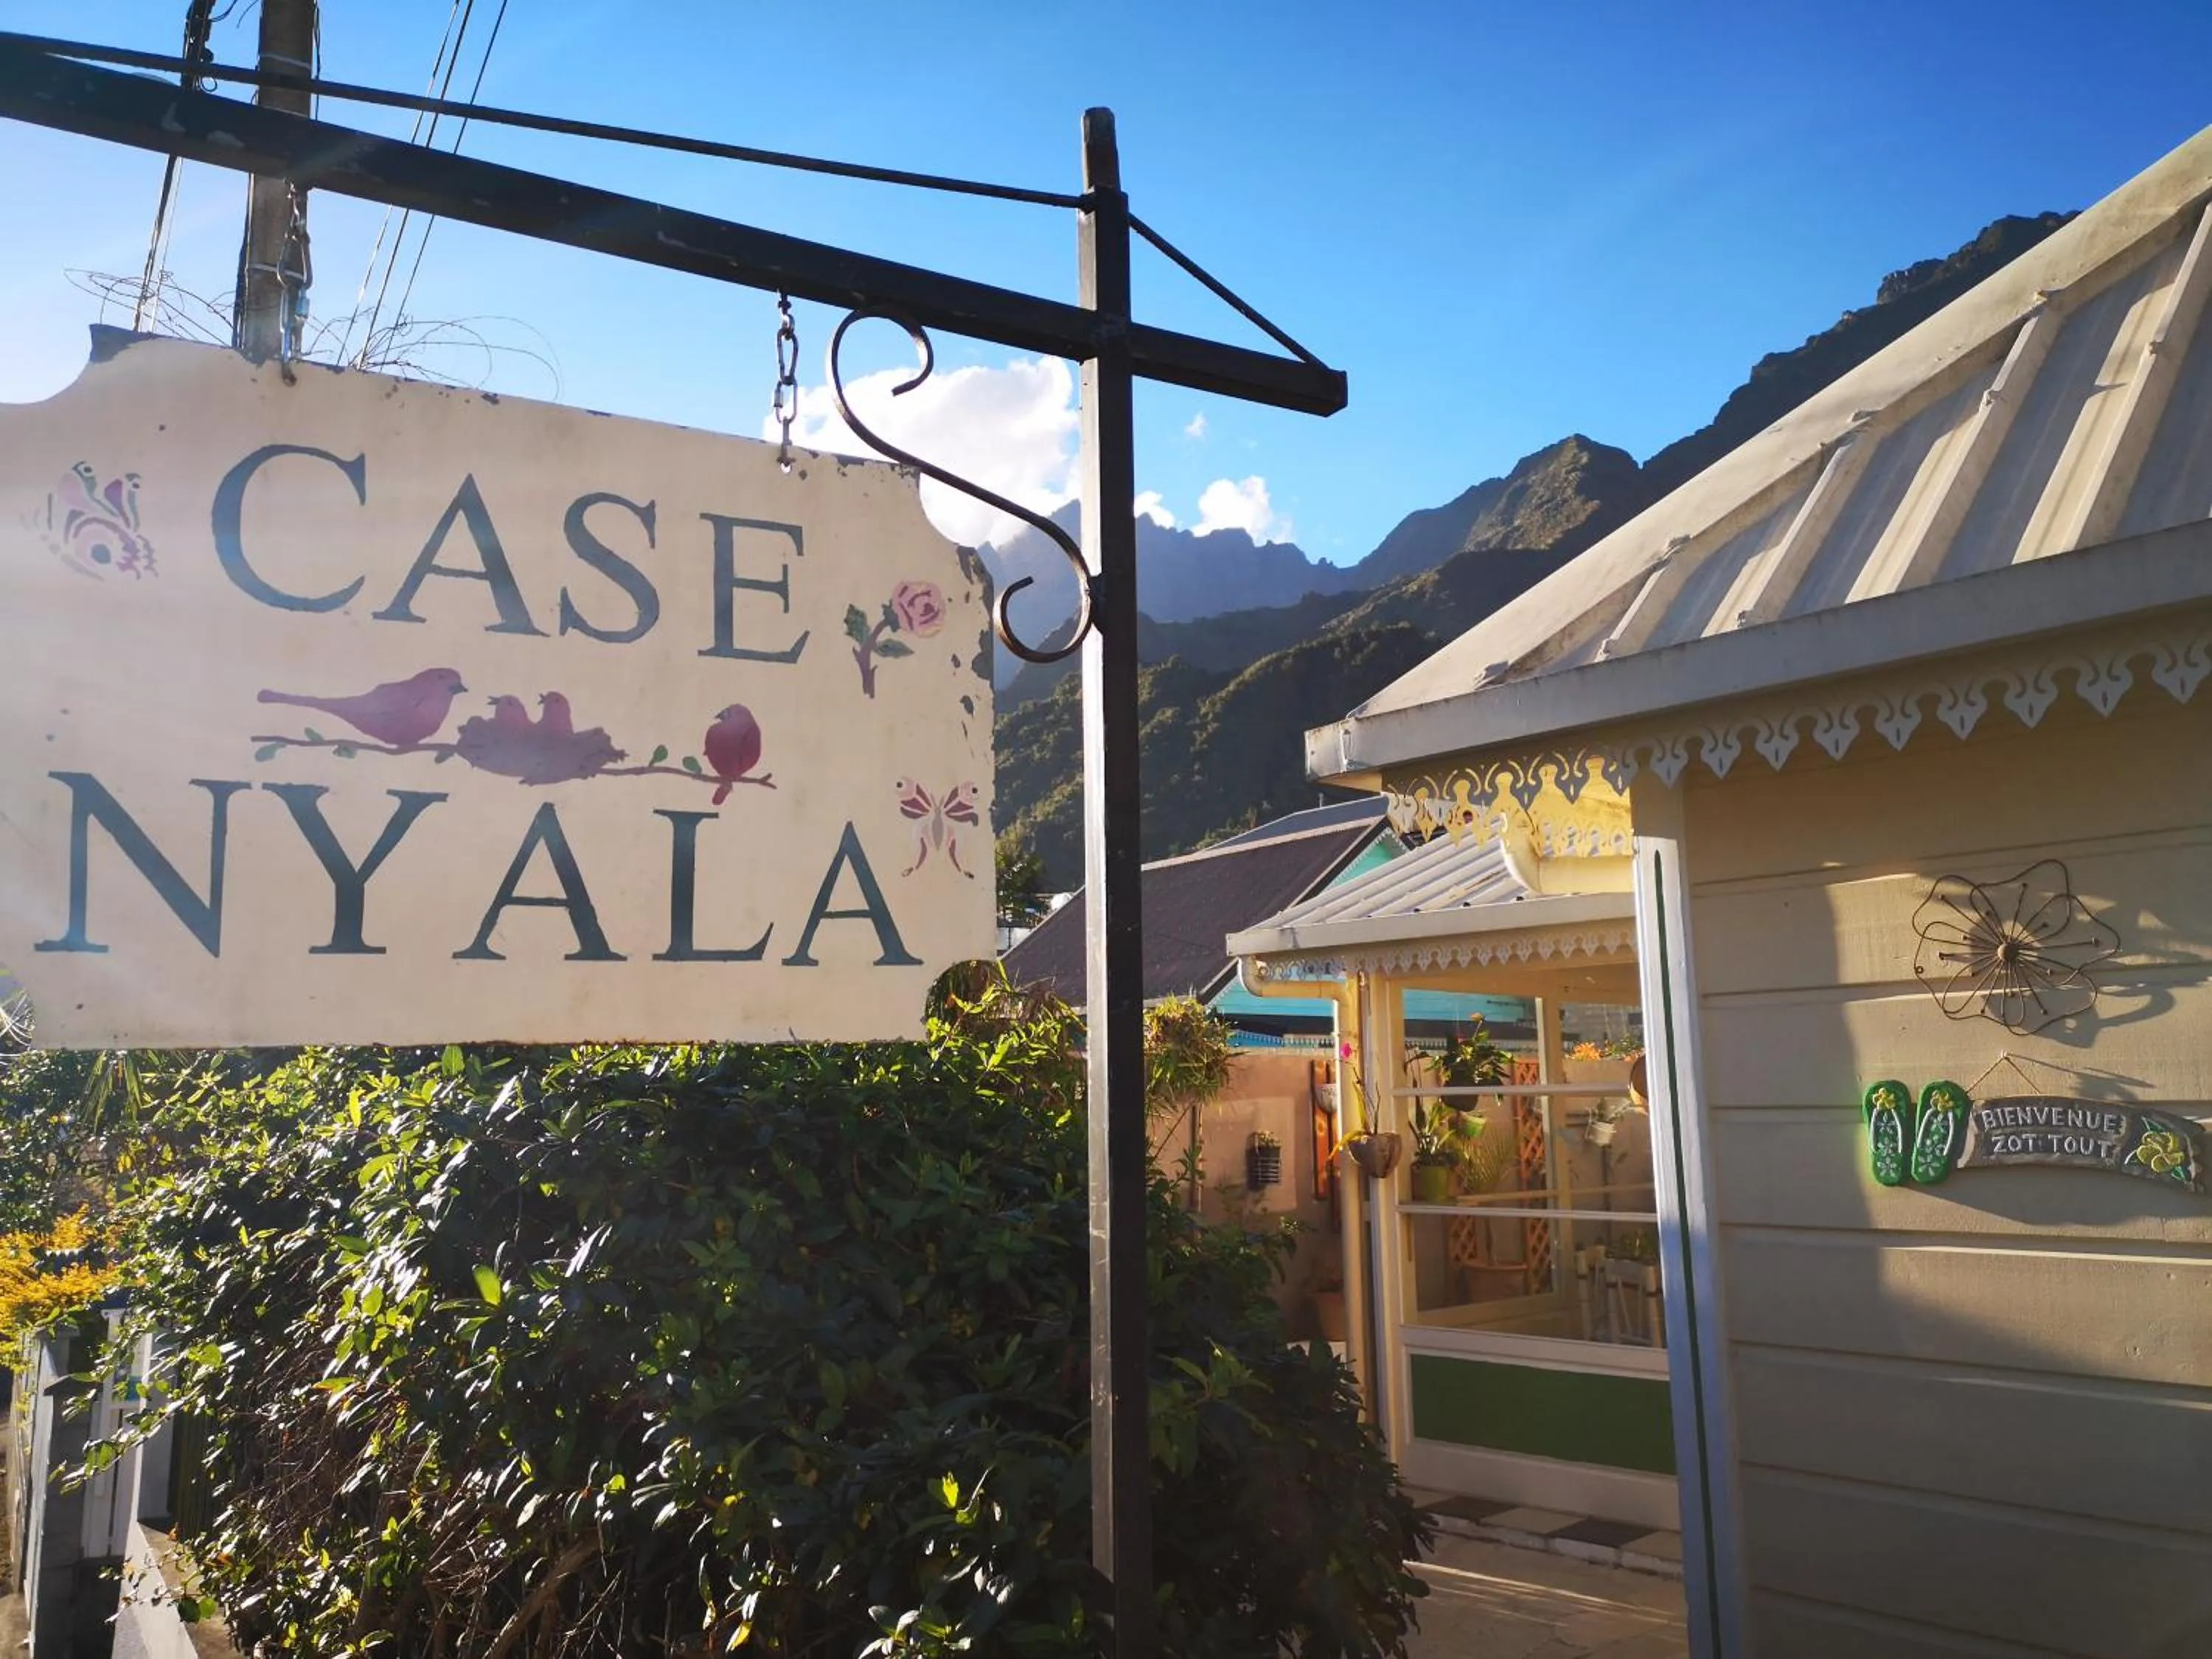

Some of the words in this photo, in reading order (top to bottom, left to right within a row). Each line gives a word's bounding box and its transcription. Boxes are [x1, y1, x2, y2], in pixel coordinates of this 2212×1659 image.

[212, 443, 810, 665] CASE
[34, 771, 924, 967] NYALA
[1981, 1106, 2117, 1133] BIENVENUE
[1992, 1133, 2037, 1154] ZOT
[2048, 1134, 2112, 1158] TOUT
